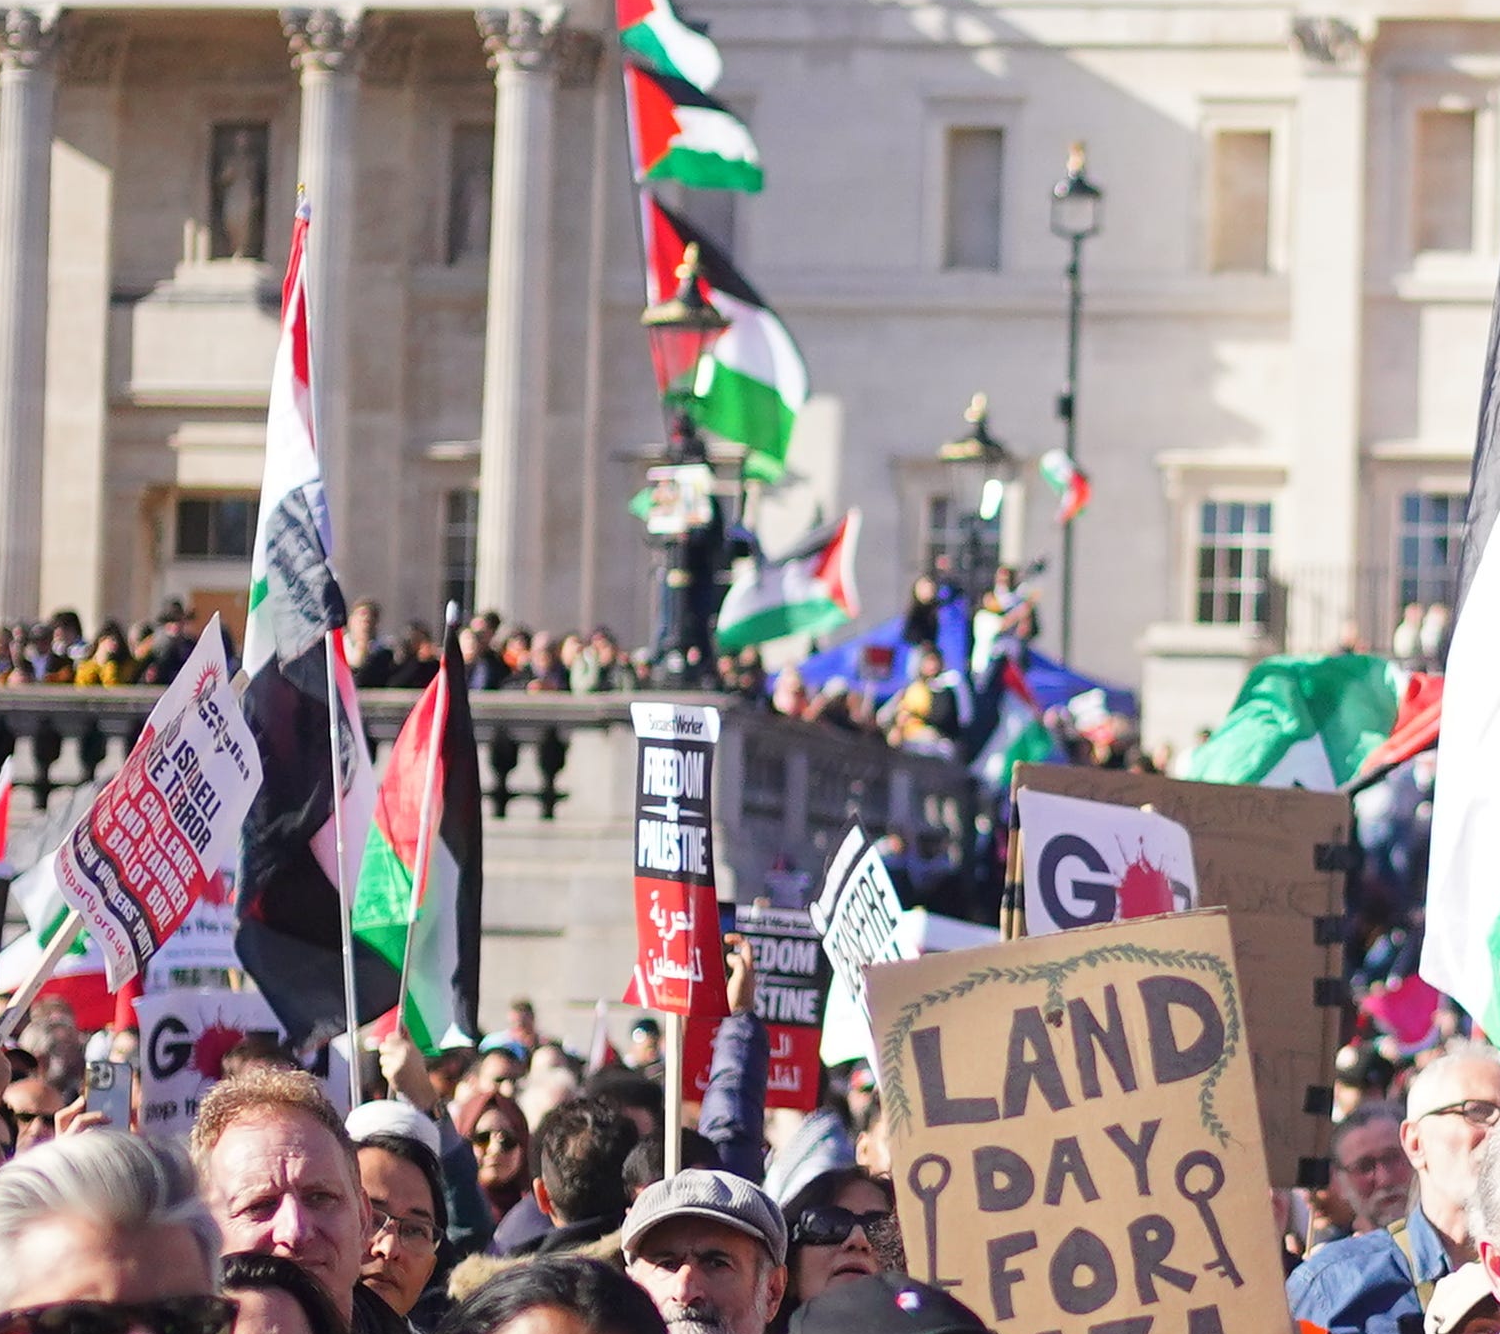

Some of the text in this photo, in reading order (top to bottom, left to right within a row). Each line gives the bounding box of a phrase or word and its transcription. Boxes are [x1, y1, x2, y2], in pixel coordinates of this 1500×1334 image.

[643, 746, 705, 800] FREEDOM
[105, 827, 151, 892] BALLOT
[114, 797, 146, 839] AND
[138, 833, 190, 915] STARMER
[638, 819, 708, 875] PALESTINE
[752, 937, 817, 975] EDOM
[754, 988, 820, 1023] STINE
[910, 975, 1225, 1127] LAND
[972, 1117, 1162, 1212] DAY
[987, 1214, 1198, 1321] FOR
